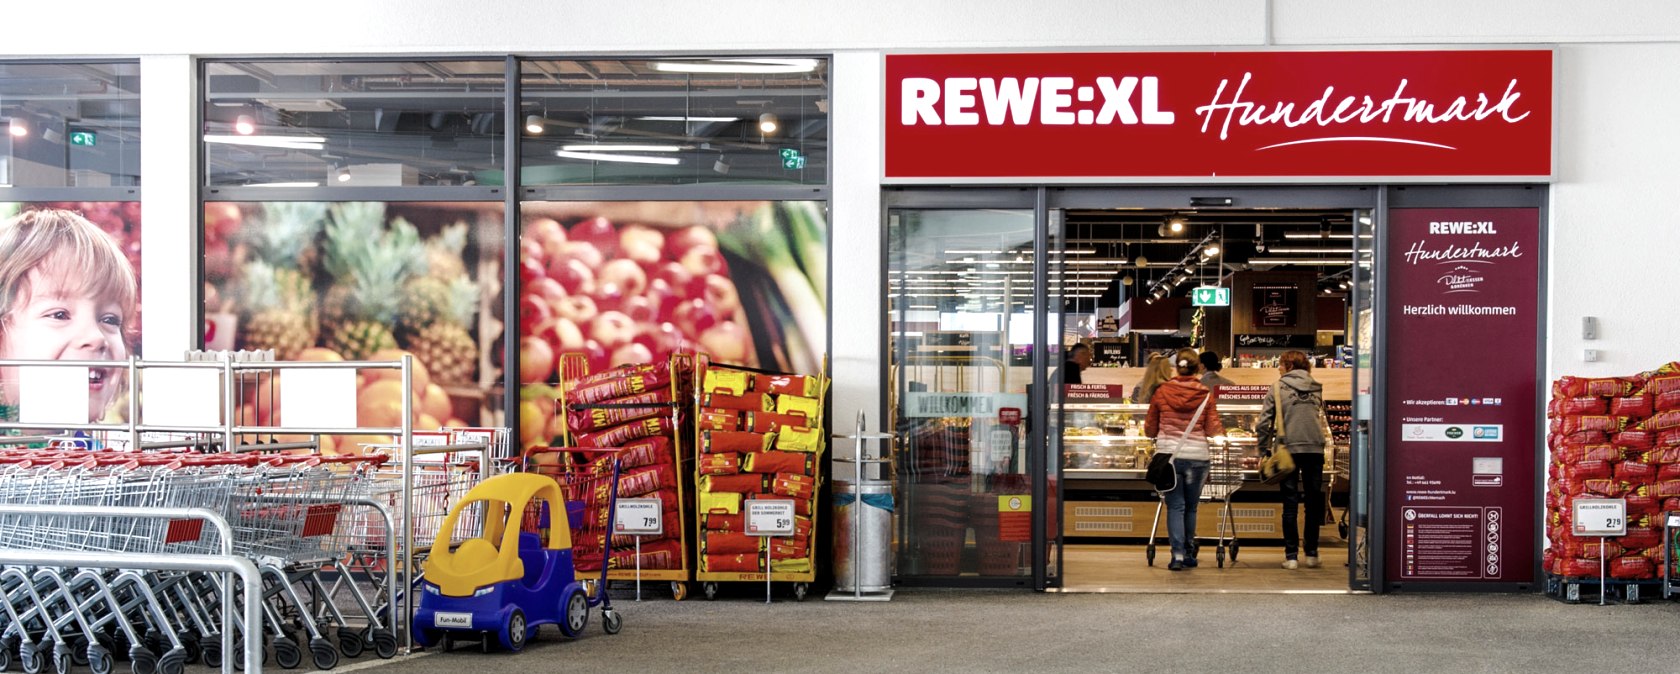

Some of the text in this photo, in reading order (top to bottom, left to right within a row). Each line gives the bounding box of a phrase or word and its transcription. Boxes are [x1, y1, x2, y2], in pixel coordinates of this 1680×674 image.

[901, 71, 1531, 140] REWE:XL Hundertmark
[1429, 221, 1497, 235] REWE:XL
[1404, 240, 1523, 265] Hundertmark
[1403, 304, 1516, 315] Herzlich willkommen
[918, 395, 993, 414] WILLKOMMEN
[440, 616, 467, 624] Fun-Mobil
